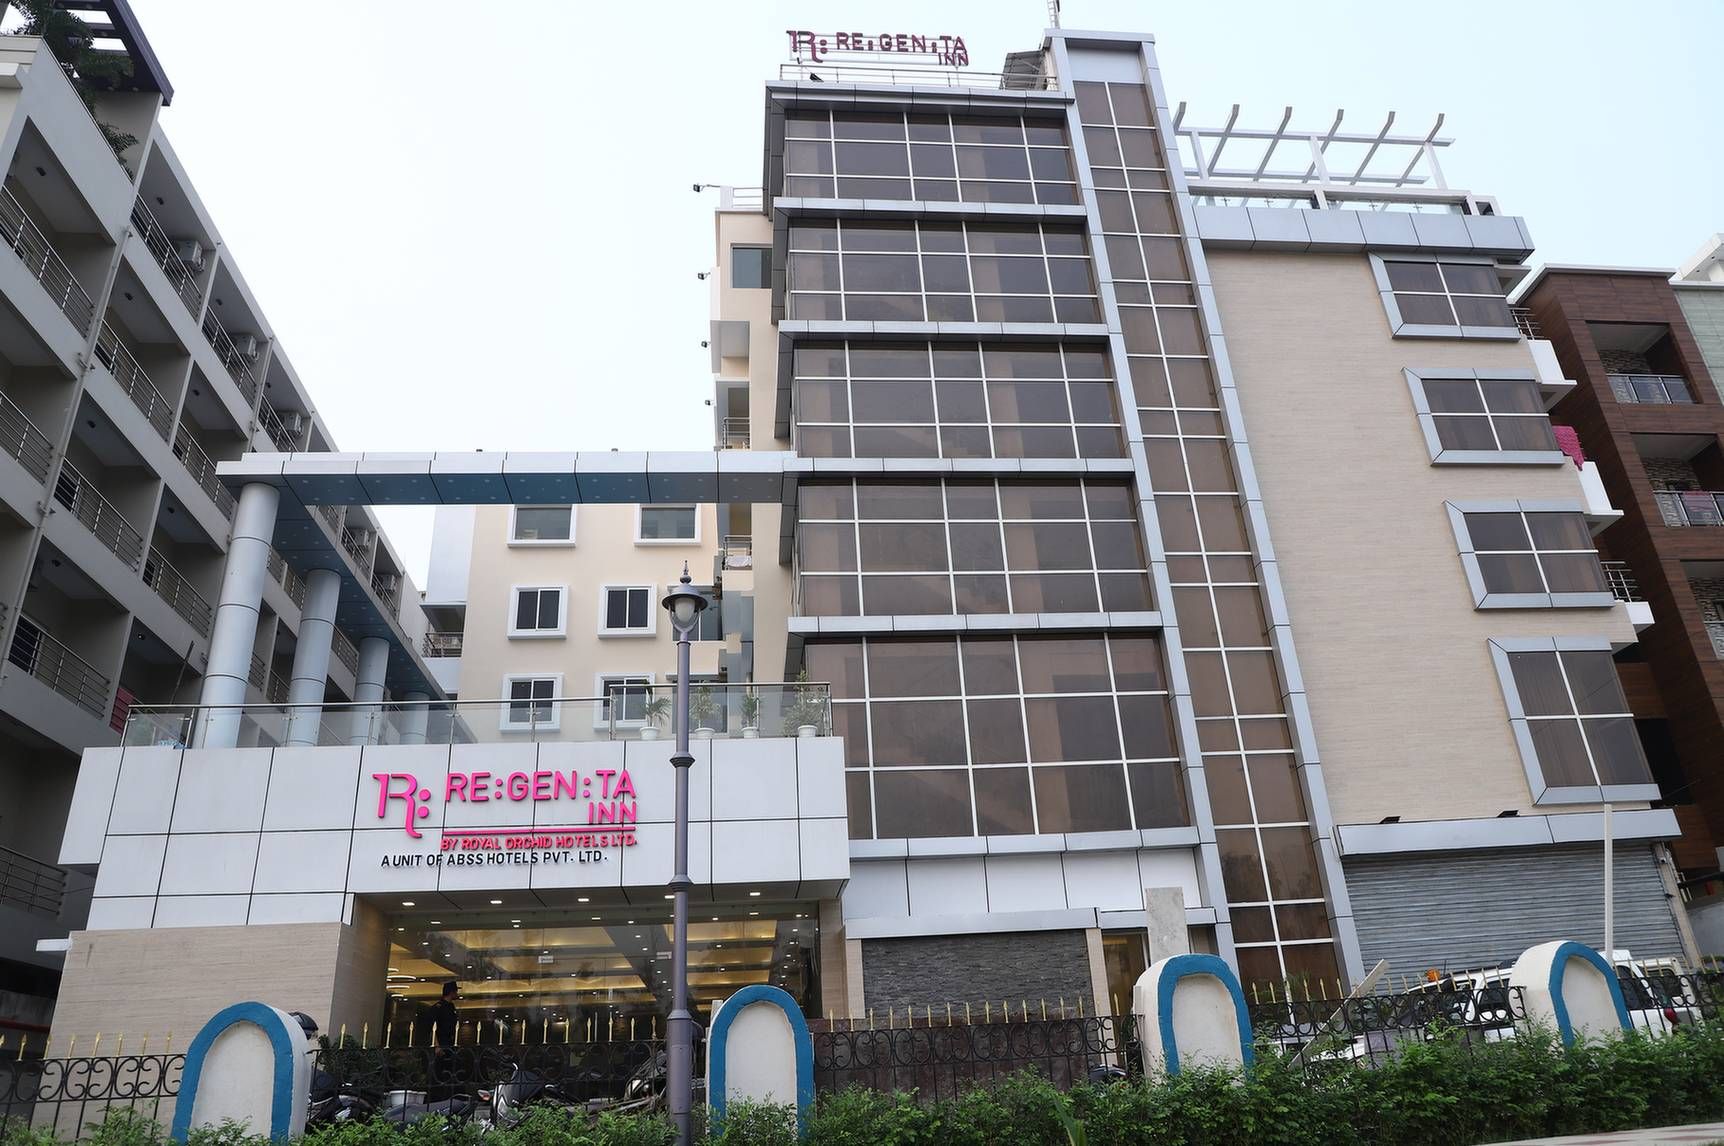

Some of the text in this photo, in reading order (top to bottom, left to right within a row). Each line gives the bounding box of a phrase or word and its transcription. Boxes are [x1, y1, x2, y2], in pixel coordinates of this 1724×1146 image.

[938, 52, 969, 66] INN
[588, 801, 637, 825] INN
[441, 834, 637, 851] BY ROYAL ORCHID HOTELS LTD.
[381, 850, 608, 867] A UNIT OF ABSS HOTELS PVT. LTD.
